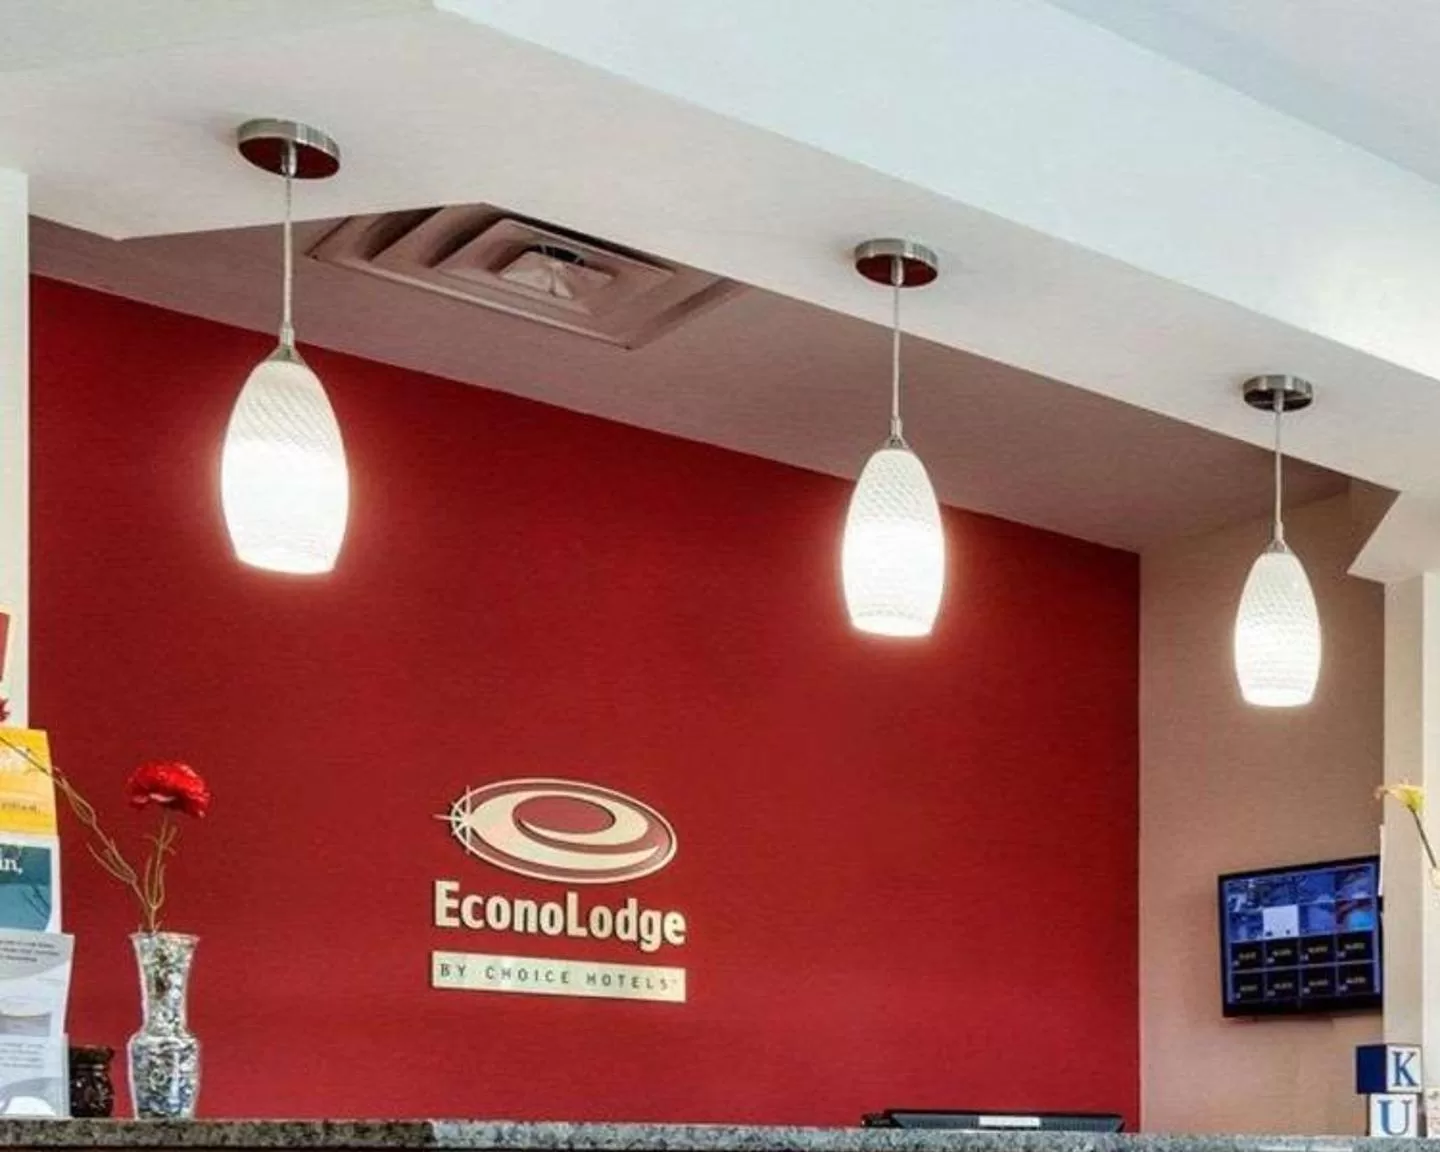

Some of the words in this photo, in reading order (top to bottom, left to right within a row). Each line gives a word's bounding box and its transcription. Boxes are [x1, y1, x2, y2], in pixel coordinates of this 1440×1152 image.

[434, 880, 687, 952] EconoLodge
[440, 963, 467, 978] BY
[485, 966, 570, 985] CHOICE
[586, 972, 669, 991] HOTELS
[1392, 1051, 1418, 1087] K
[1377, 1100, 1411, 1136] U
